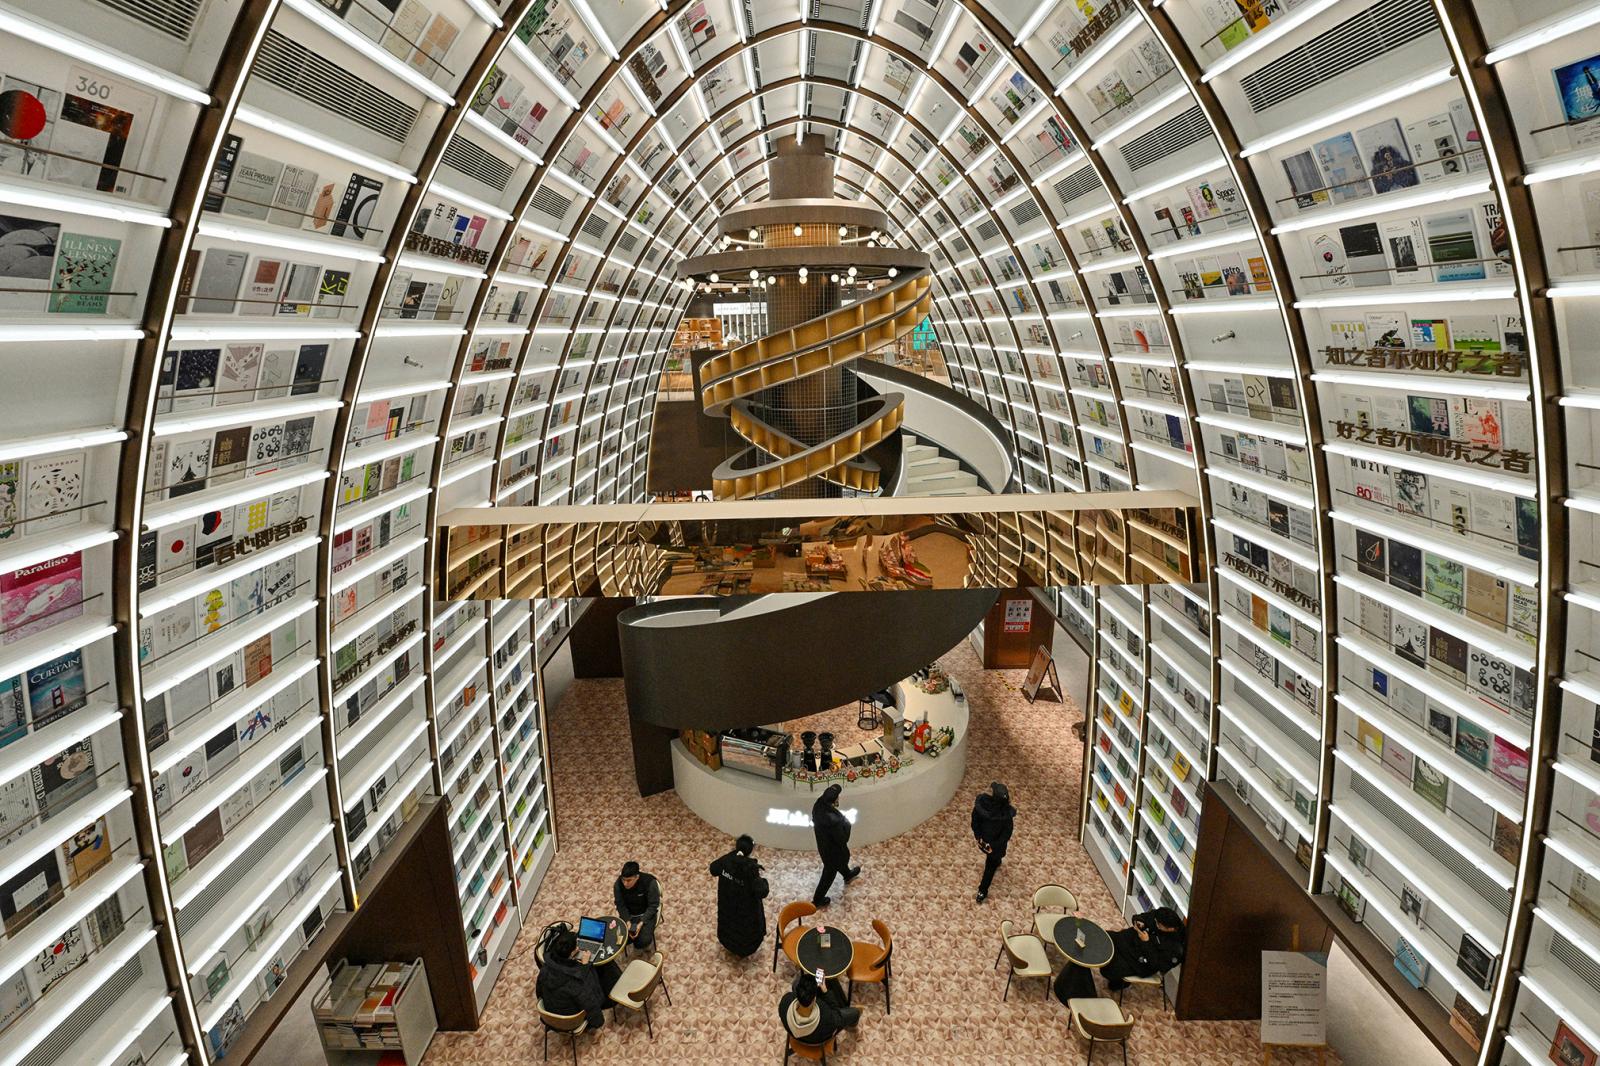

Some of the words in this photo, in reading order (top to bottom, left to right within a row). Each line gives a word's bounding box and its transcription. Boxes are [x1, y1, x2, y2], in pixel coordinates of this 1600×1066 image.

[1069, 0, 1135, 58] 知识就是力
[1326, 345, 1521, 378] 知之者不如好之者
[1335, 419, 1533, 475] 好之者不如乐之者
[1350, 457, 1390, 476] MUZIK
[1356, 485, 1373, 500] 80
[14, 555, 69, 580] Paradiso
[30, 656, 81, 685] CURTAIN
